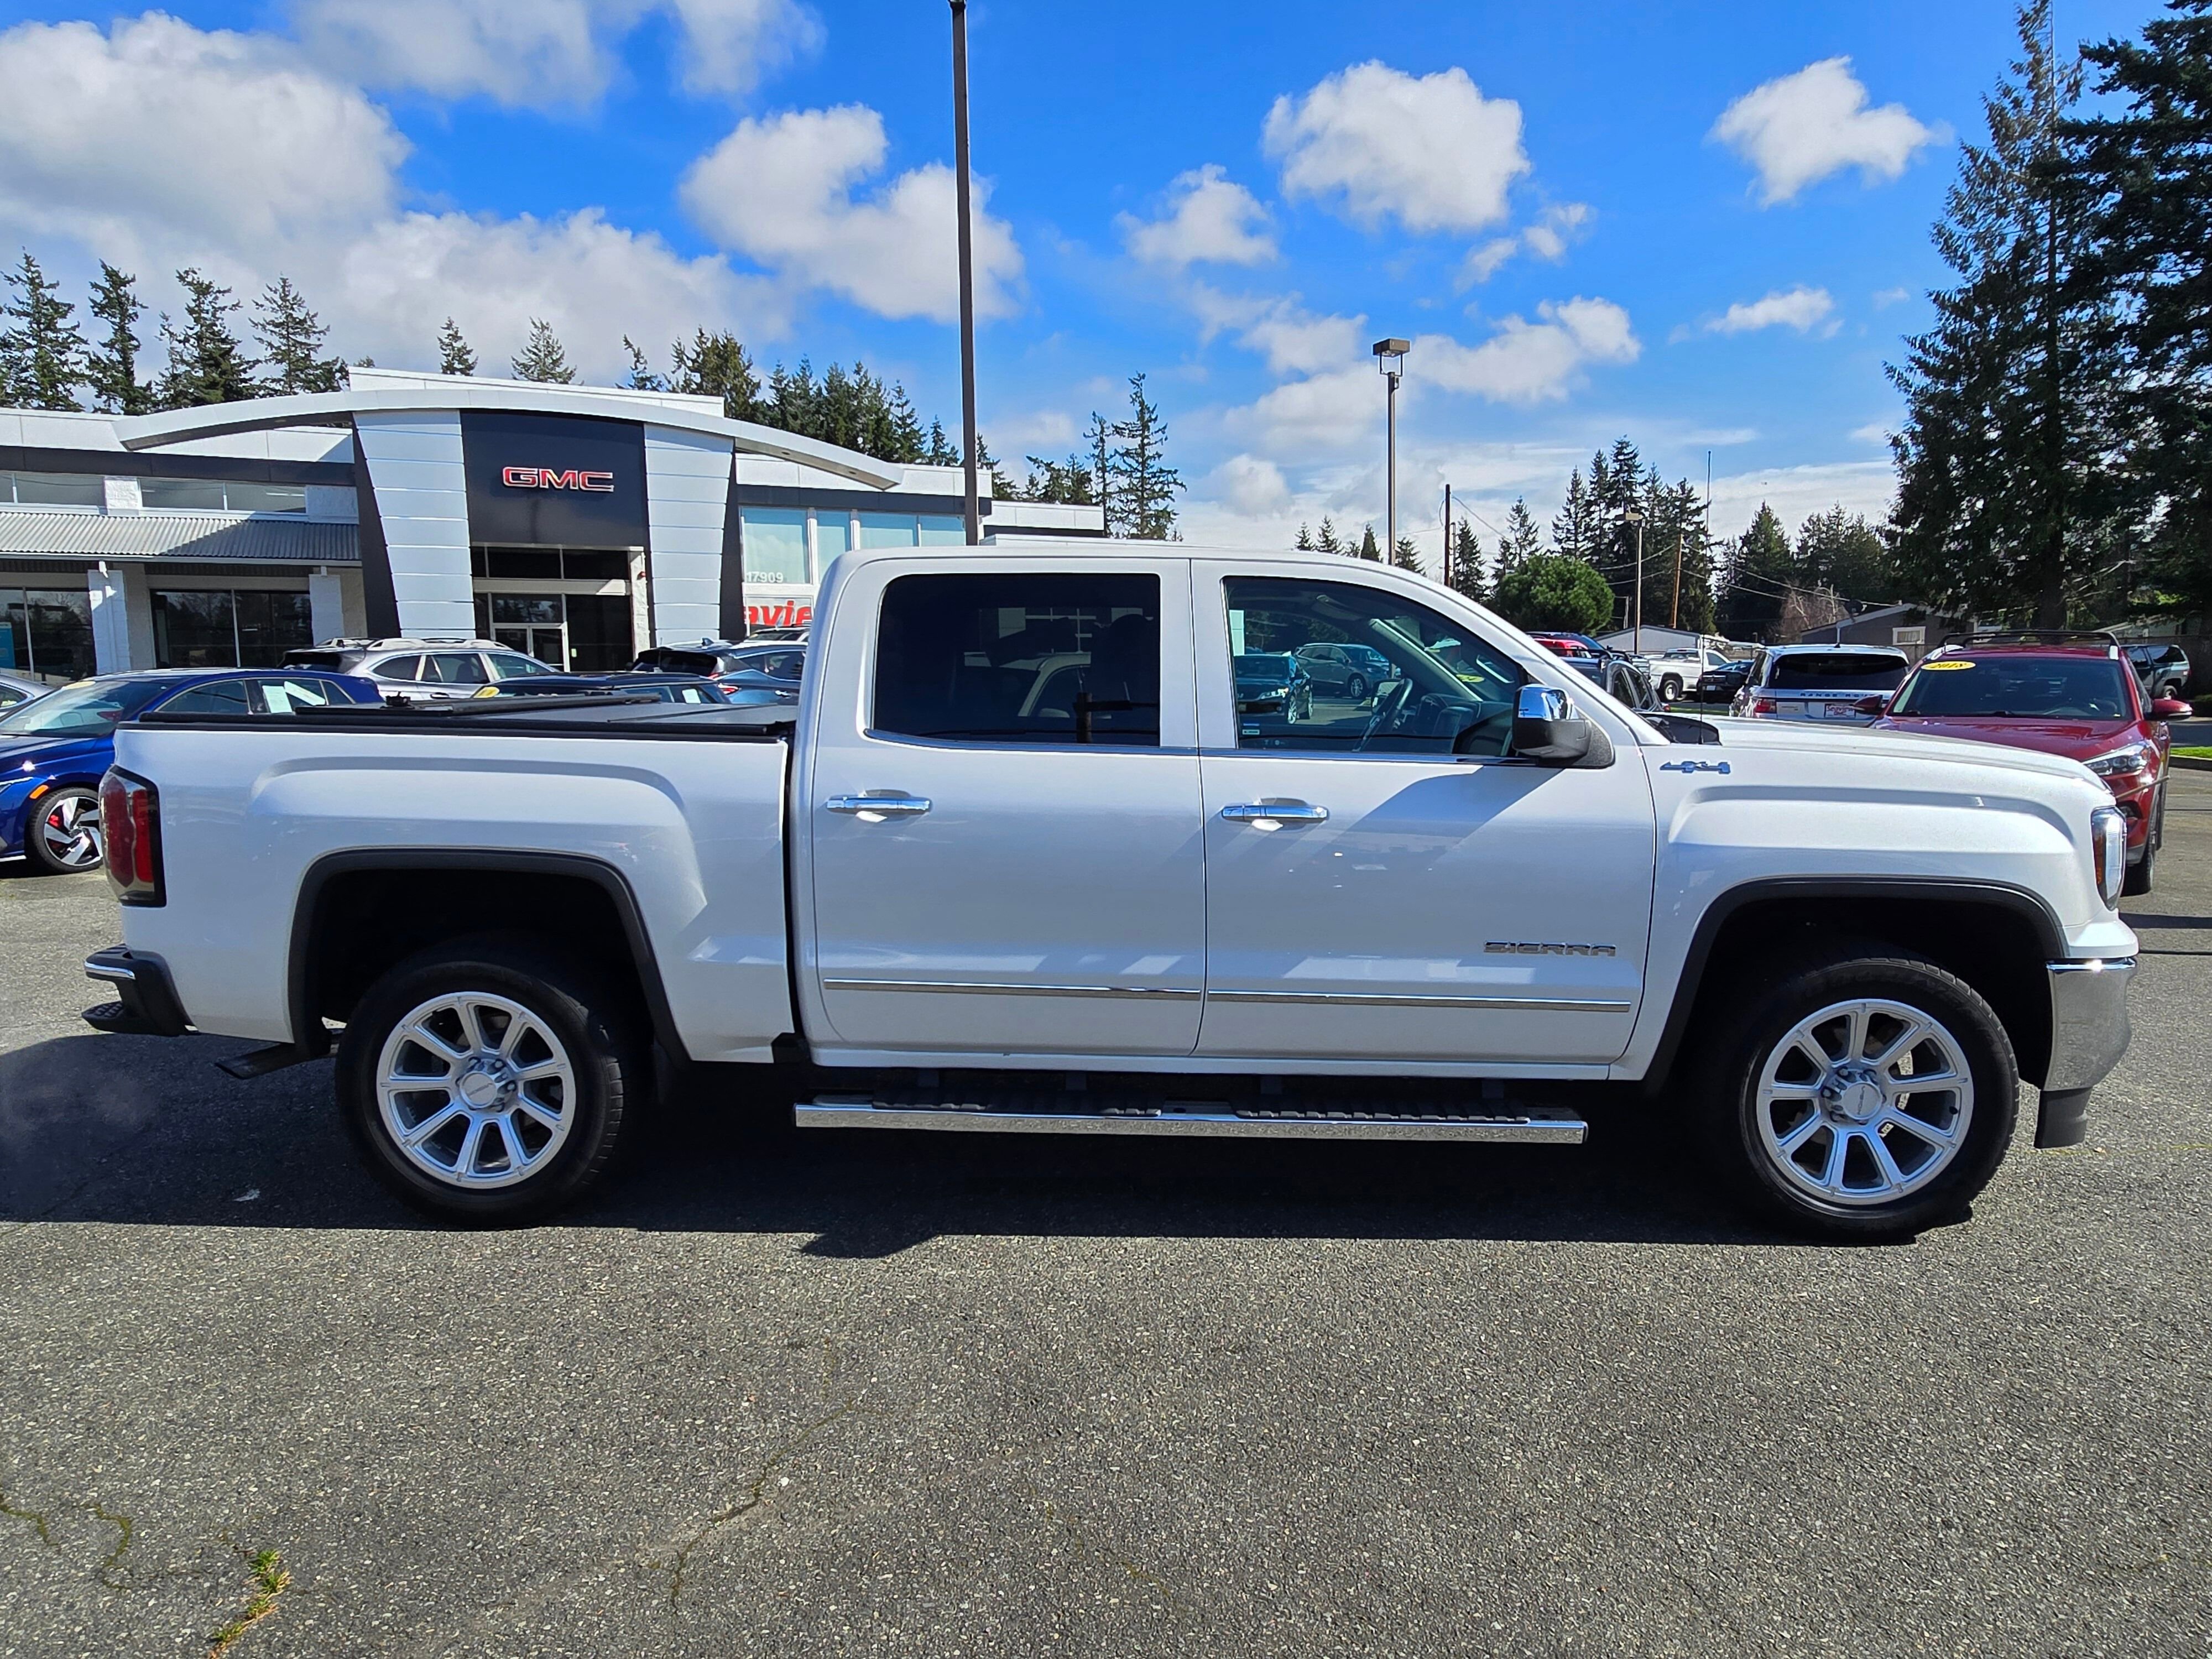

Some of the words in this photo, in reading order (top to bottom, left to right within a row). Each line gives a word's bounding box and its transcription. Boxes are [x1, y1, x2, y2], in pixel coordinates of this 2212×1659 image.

[502, 466, 614, 493] GMC
[747, 571, 784, 583] 17909
[1484, 941, 1616, 957] SIERRA
